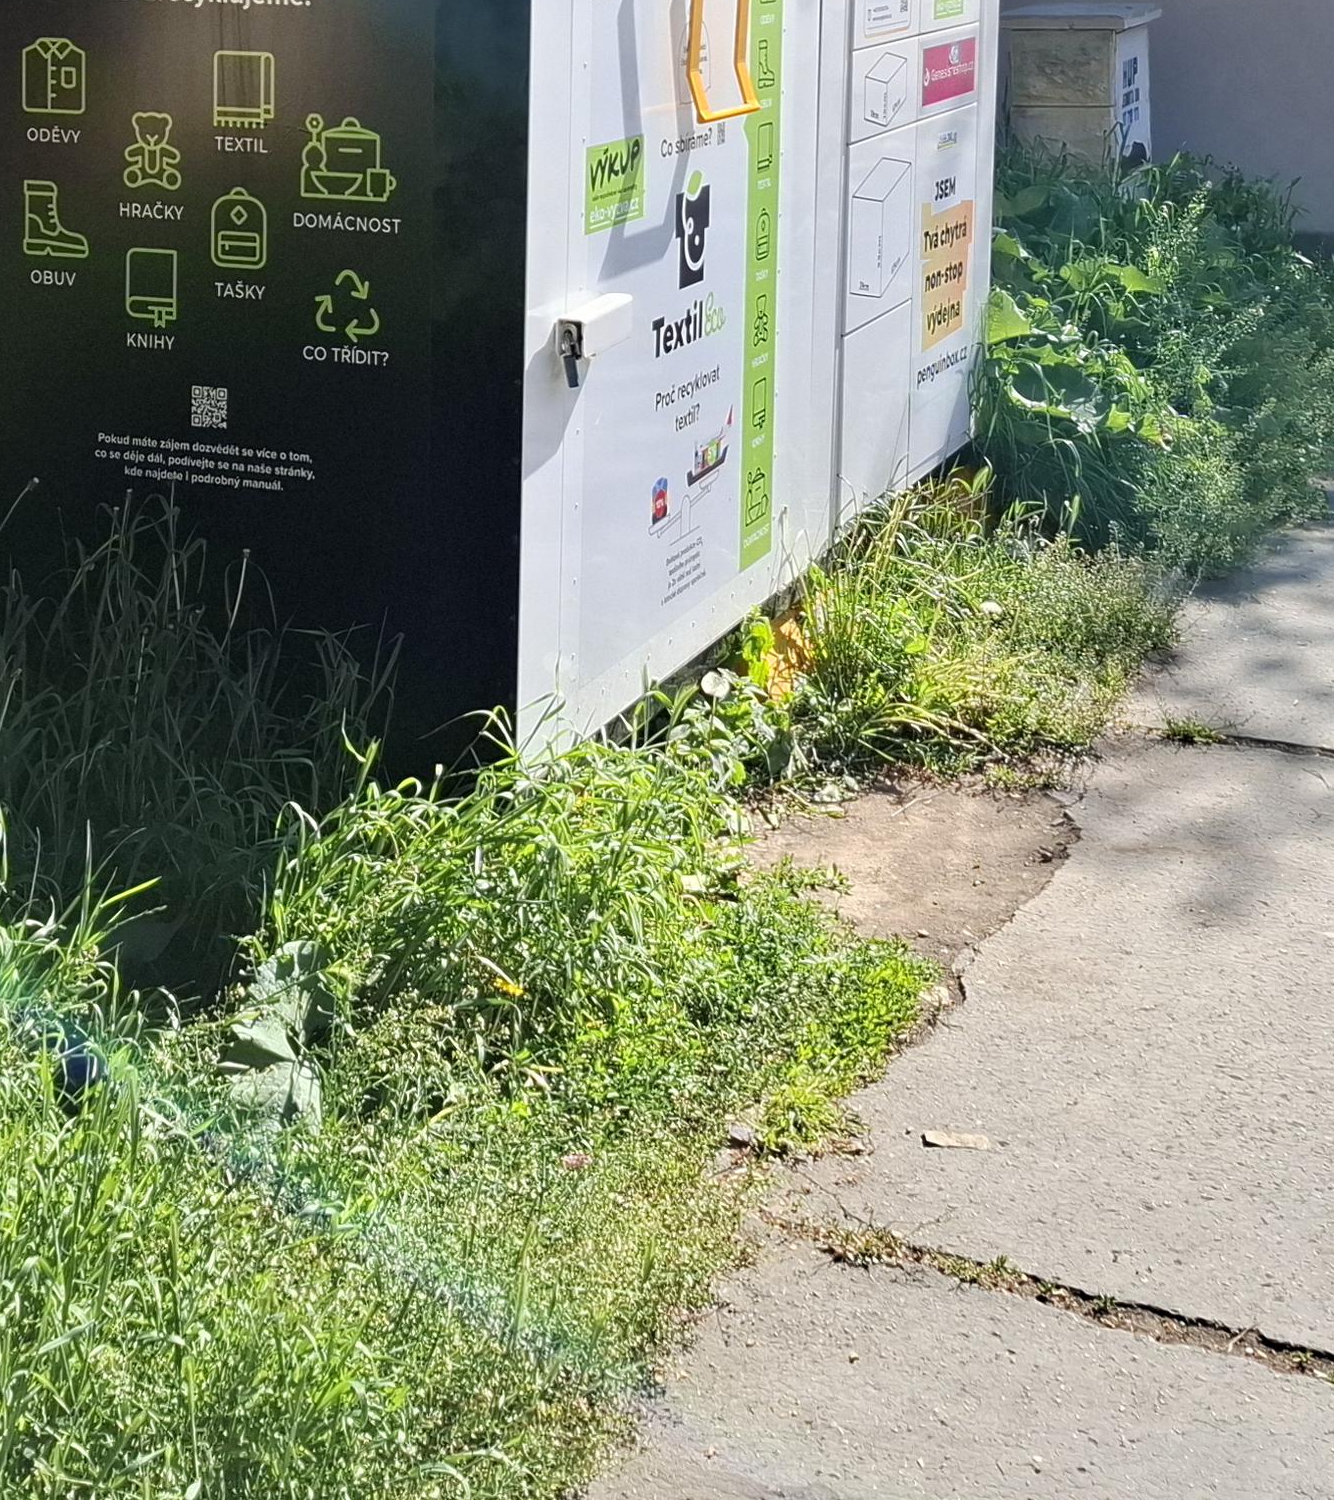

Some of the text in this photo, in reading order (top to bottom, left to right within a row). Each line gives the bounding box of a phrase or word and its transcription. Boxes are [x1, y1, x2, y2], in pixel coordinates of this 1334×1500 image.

[27, 125, 80, 144] ODĚVY
[215, 136, 268, 154] TEXTIL
[660, 139, 673, 158] Co
[590, 138, 641, 193] VÝKUP
[935, 176, 957, 201] JSEM
[119, 201, 185, 221] HRAČKY
[293, 212, 402, 235] DOMÁCNOST
[924, 215, 967, 253] Tvá chytrá
[30, 269, 77, 287] OBUV
[925, 261, 964, 292] non-stop
[215, 280, 266, 300] TAŠKY
[927, 299, 960, 336] výdejna
[126, 333, 175, 350] KNIHY
[303, 345, 389, 367] CO TŘÍDIT?
[917, 346, 968, 390] penguinbox.cz
[655, 363, 720, 412] Proč recyklovat
[675, 403, 700, 432] textil?
[98, 432, 313, 463] Pokud máte zájem dozvědět se více o tom,
[95, 450, 316, 480] co se děje dál, podívejte se na naše stránky,
[124, 466, 143, 477] kde
[145, 469, 183, 481] najdete
[191, 472, 240, 488] podrobný
[242, 476, 284, 491] manuál.
